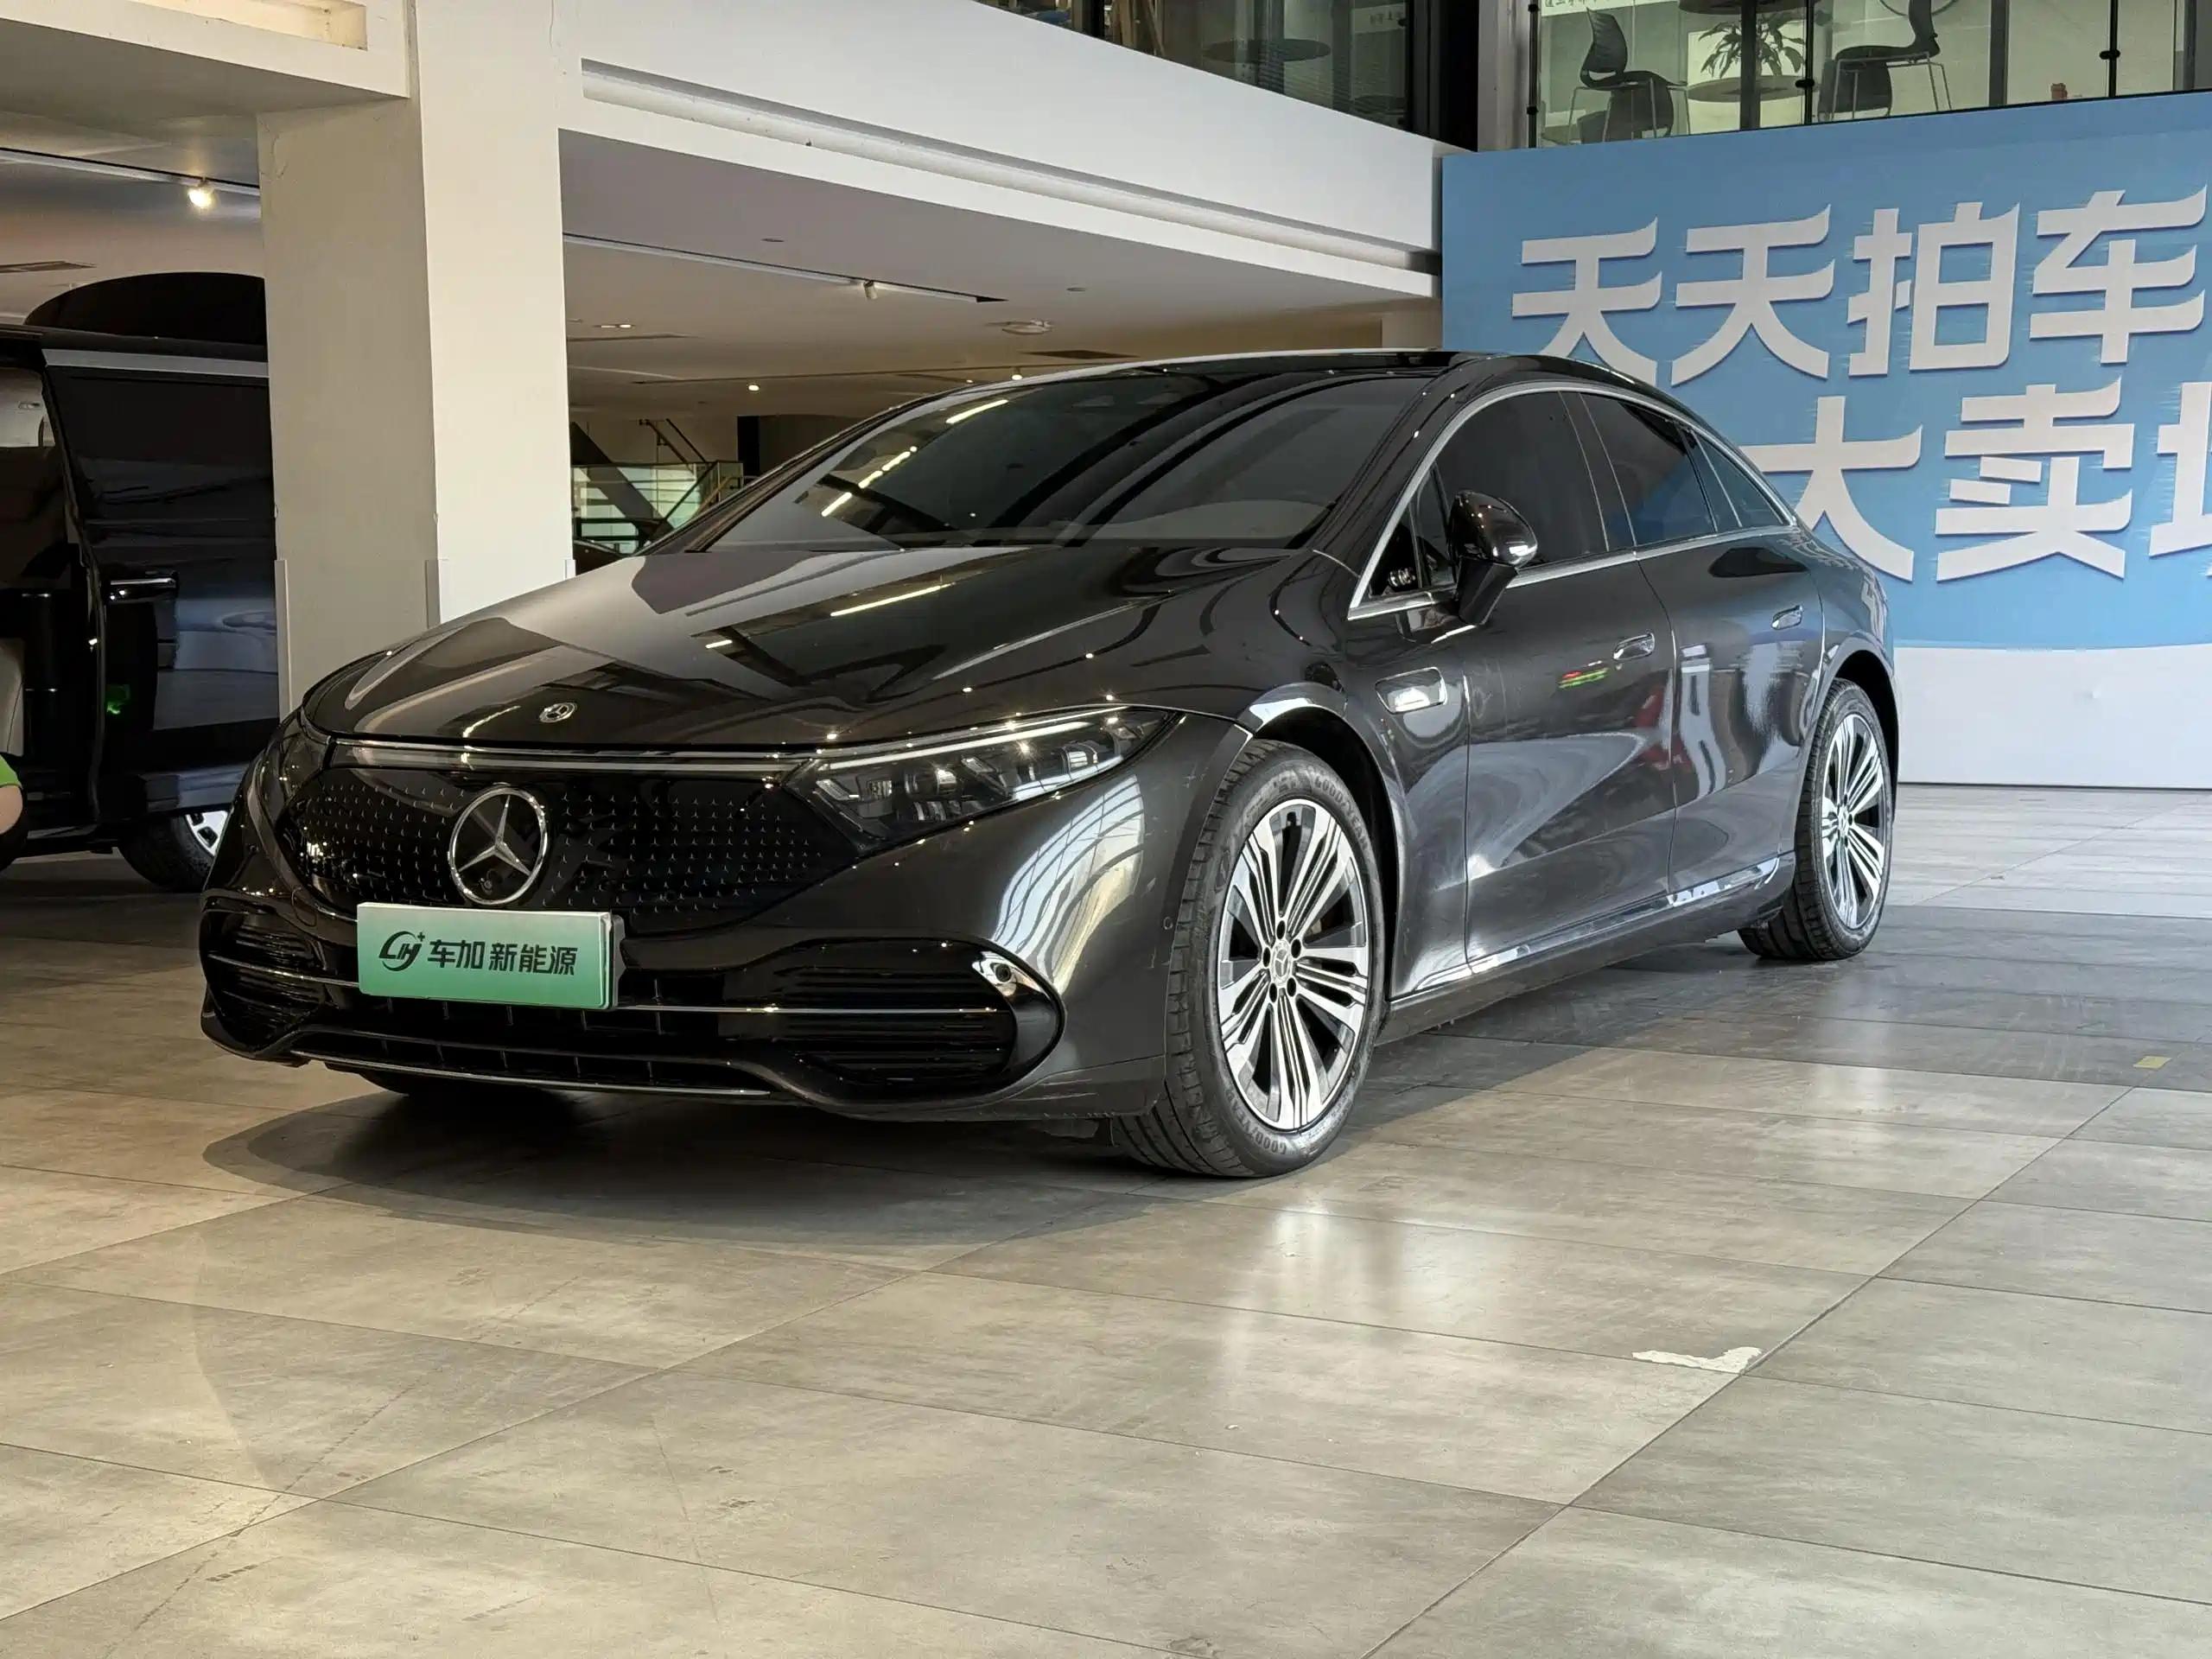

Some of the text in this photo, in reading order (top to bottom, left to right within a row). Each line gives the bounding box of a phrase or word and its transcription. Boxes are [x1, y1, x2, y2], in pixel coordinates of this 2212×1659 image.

[1512, 184, 2208, 387] 天天拍车
[427, 938, 578, 976] 车加新能源
